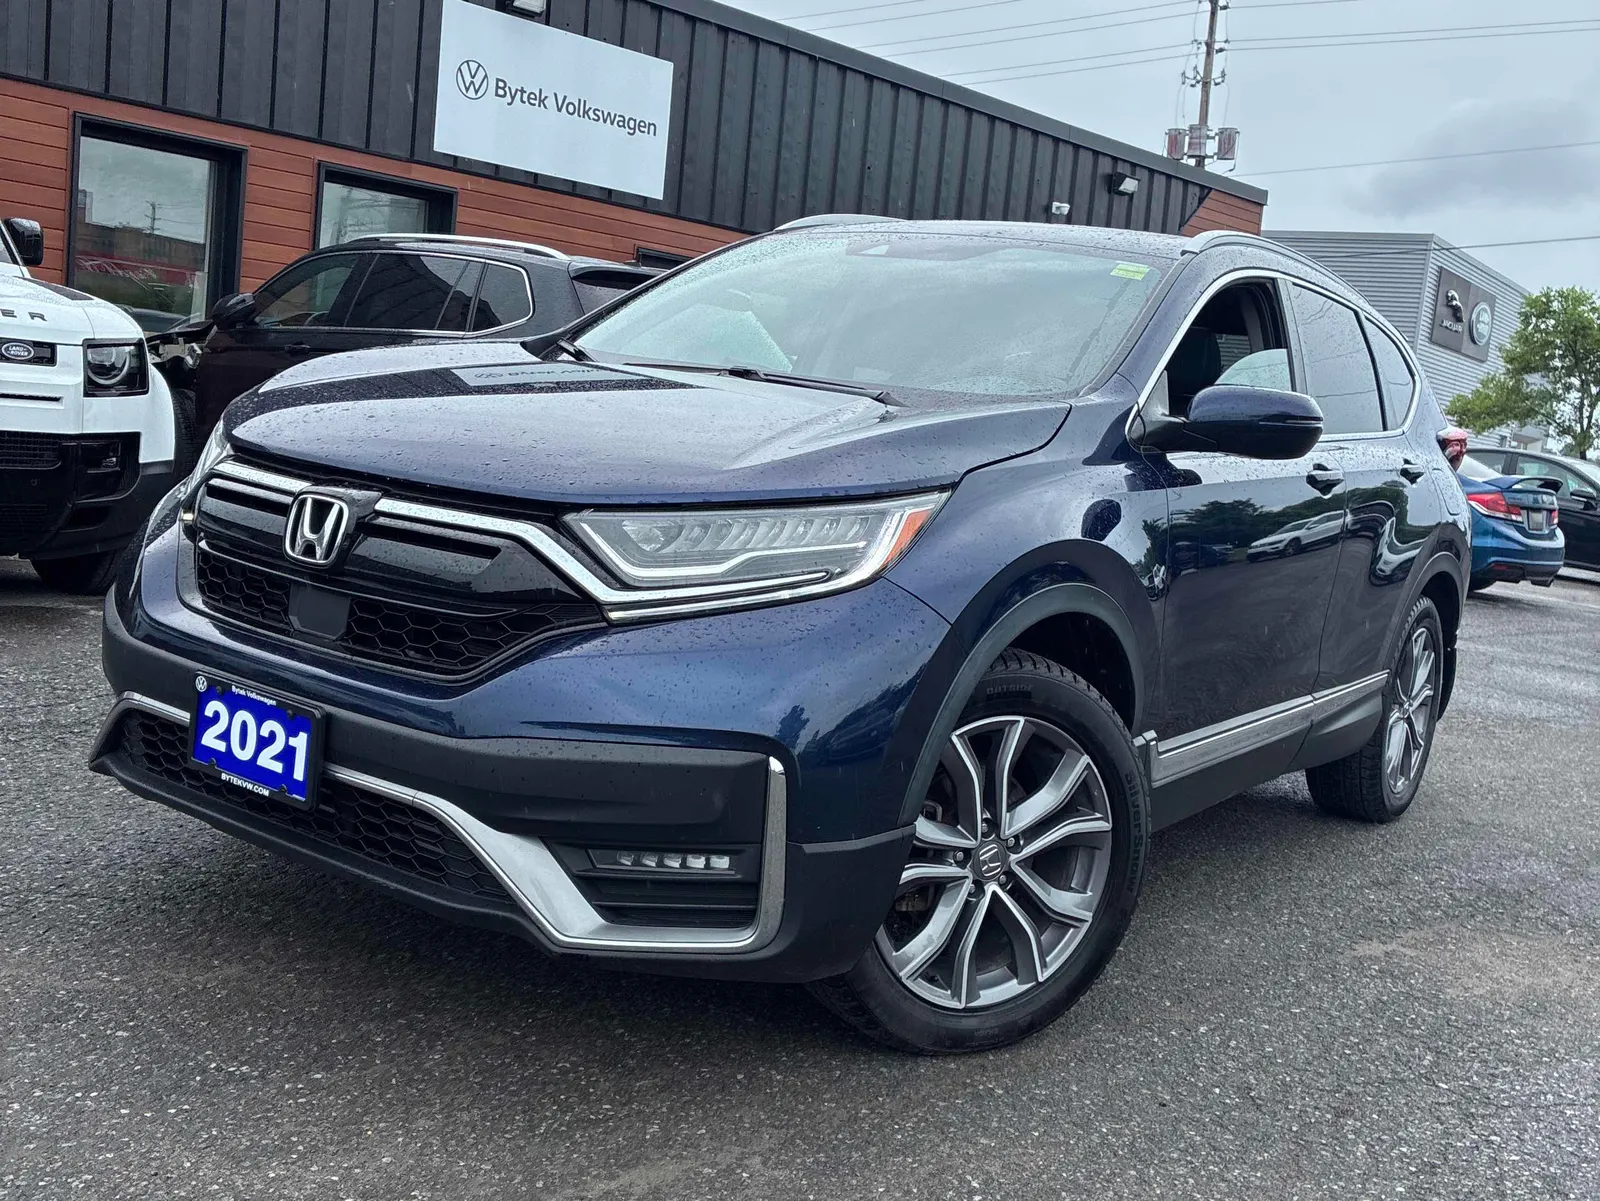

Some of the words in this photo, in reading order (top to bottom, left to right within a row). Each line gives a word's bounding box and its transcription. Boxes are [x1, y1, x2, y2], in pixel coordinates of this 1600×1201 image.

[494, 77, 549, 110] Bytek
[553, 92, 657, 136] Volkswagen
[231, 685, 246, 697] Bytek
[246, 690, 277, 706] Volkswagen
[201, 700, 308, 782] 2021
[221, 772, 270, 797] BYTEKVW.COM
